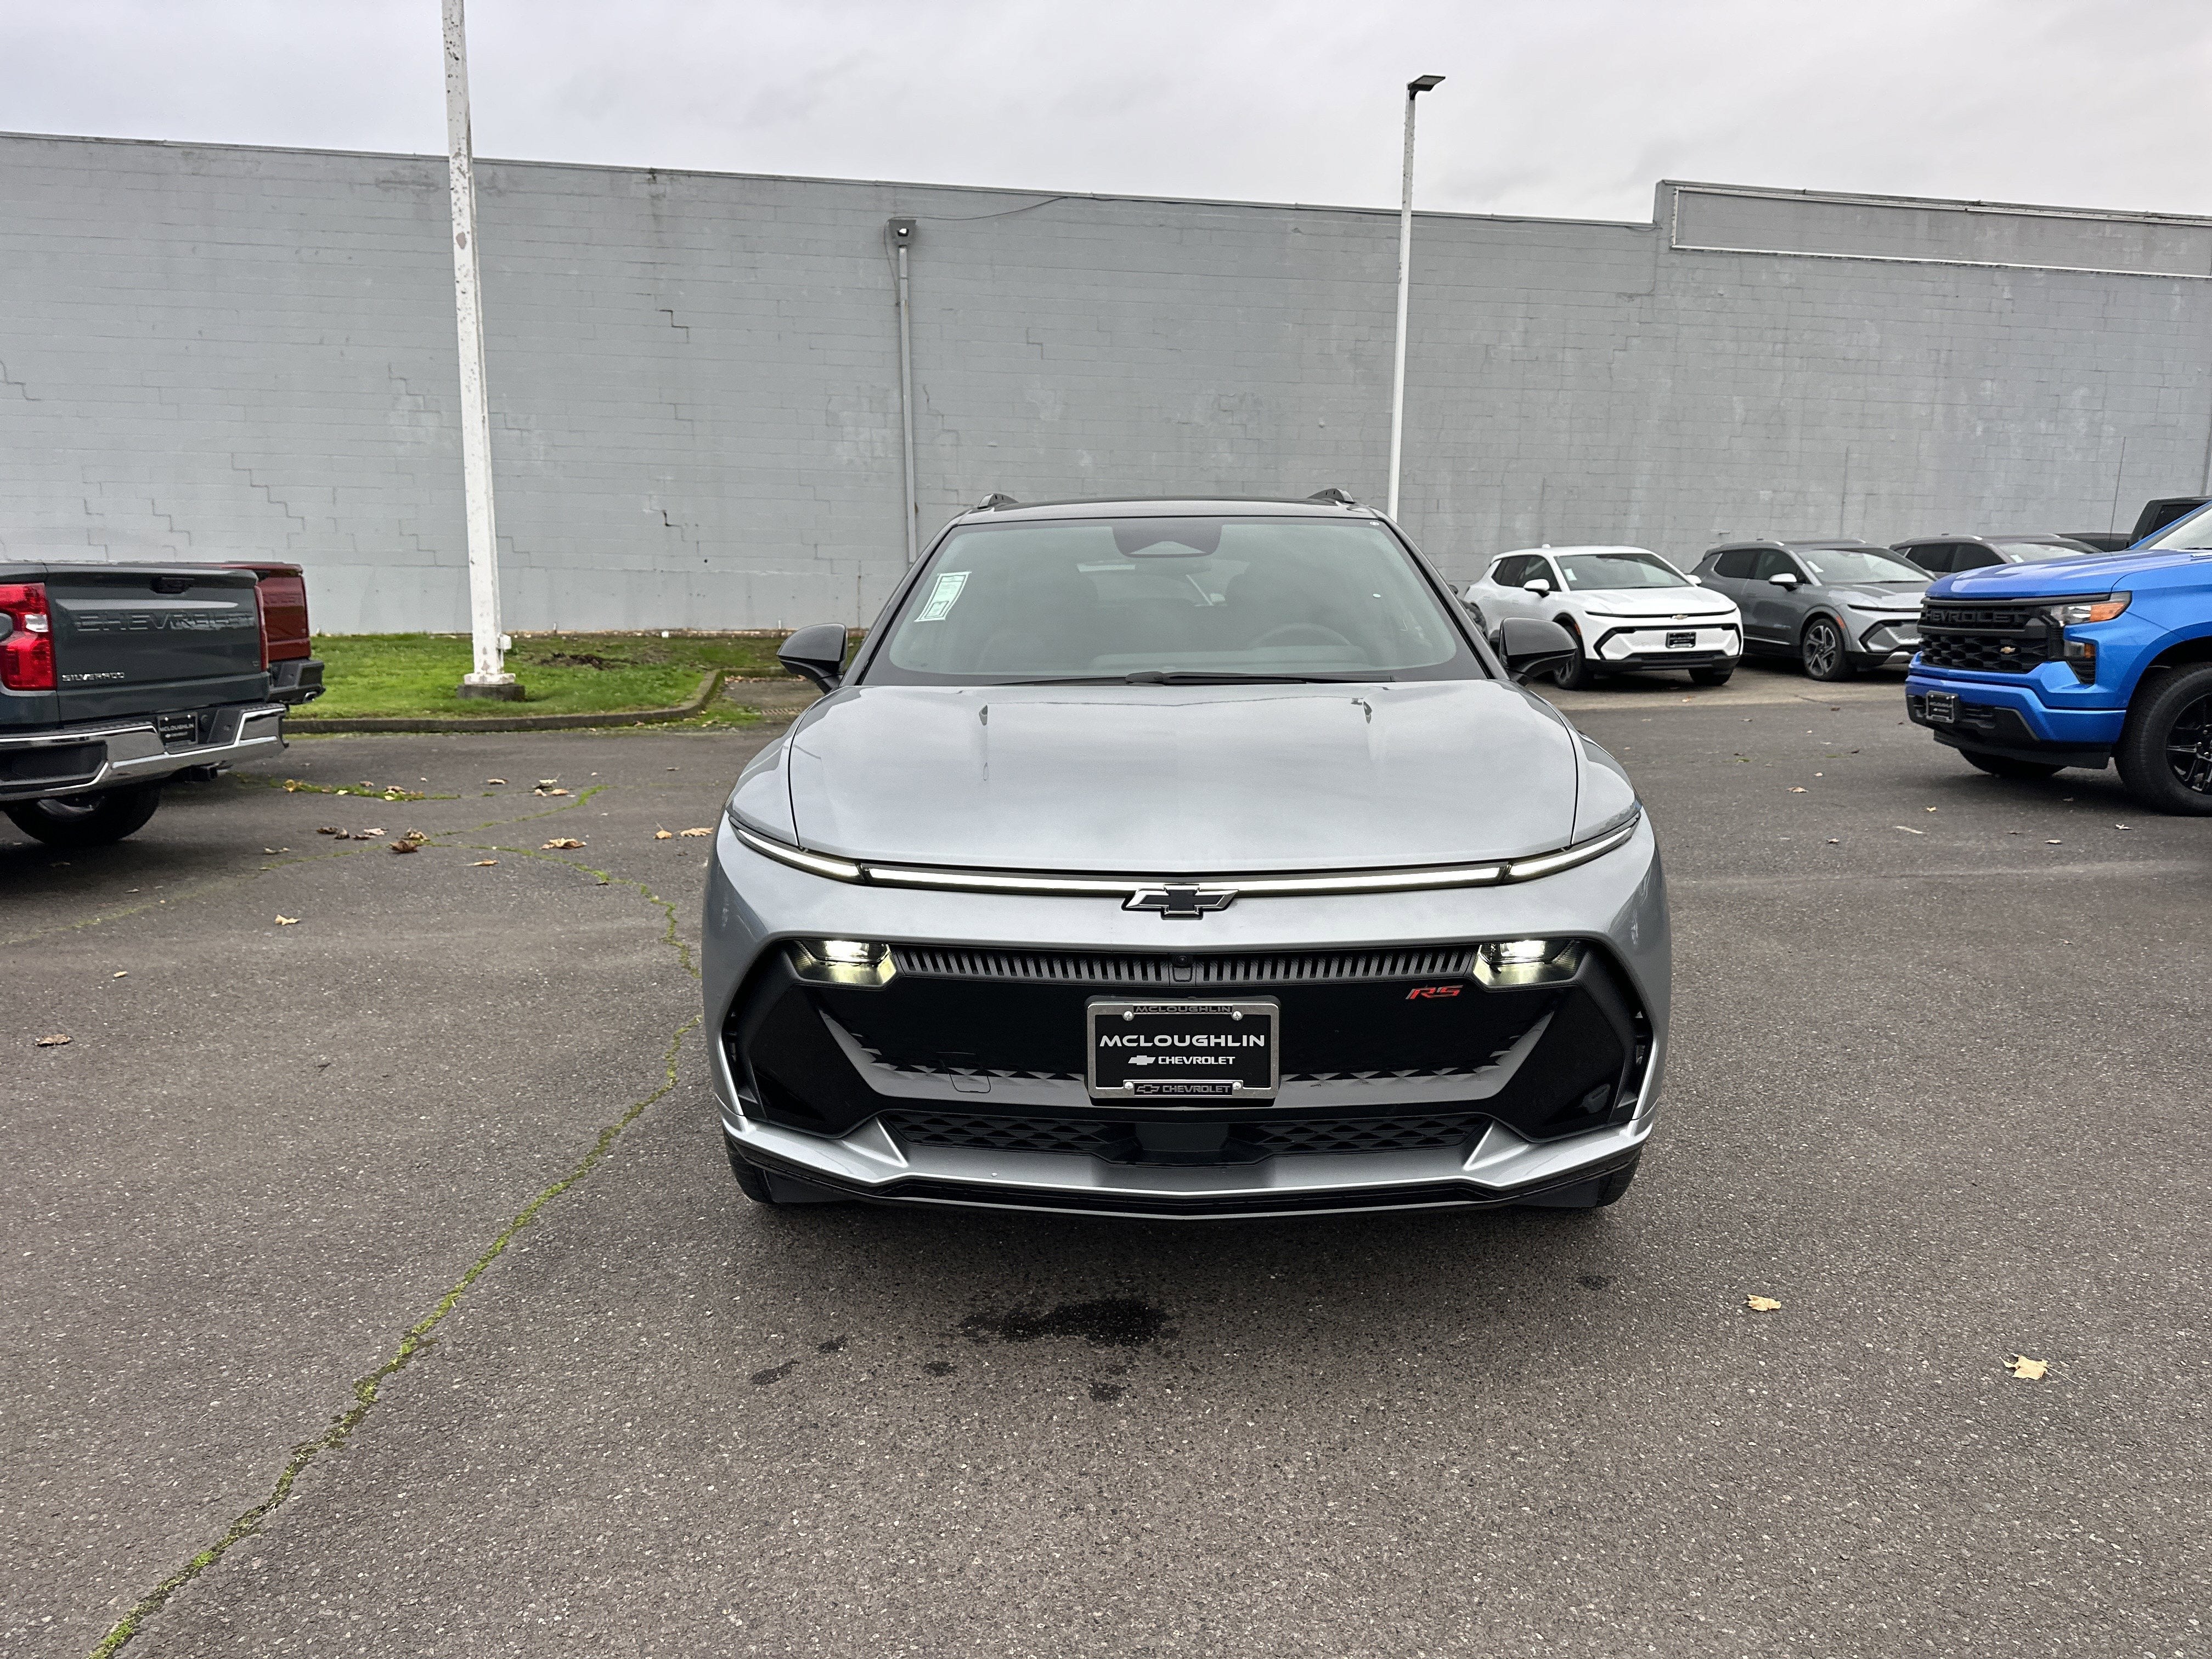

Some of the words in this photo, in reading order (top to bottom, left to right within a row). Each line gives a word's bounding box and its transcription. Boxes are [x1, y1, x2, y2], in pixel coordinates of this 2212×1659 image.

[75, 611, 256, 631] CHEVROLET
[62, 672, 125, 682] SILVERADO
[1406, 985, 1463, 1000] RS
[1099, 1035, 1265, 1047] MCLOUGHLIN
[1158, 1056, 1235, 1065] CHEVROLET
